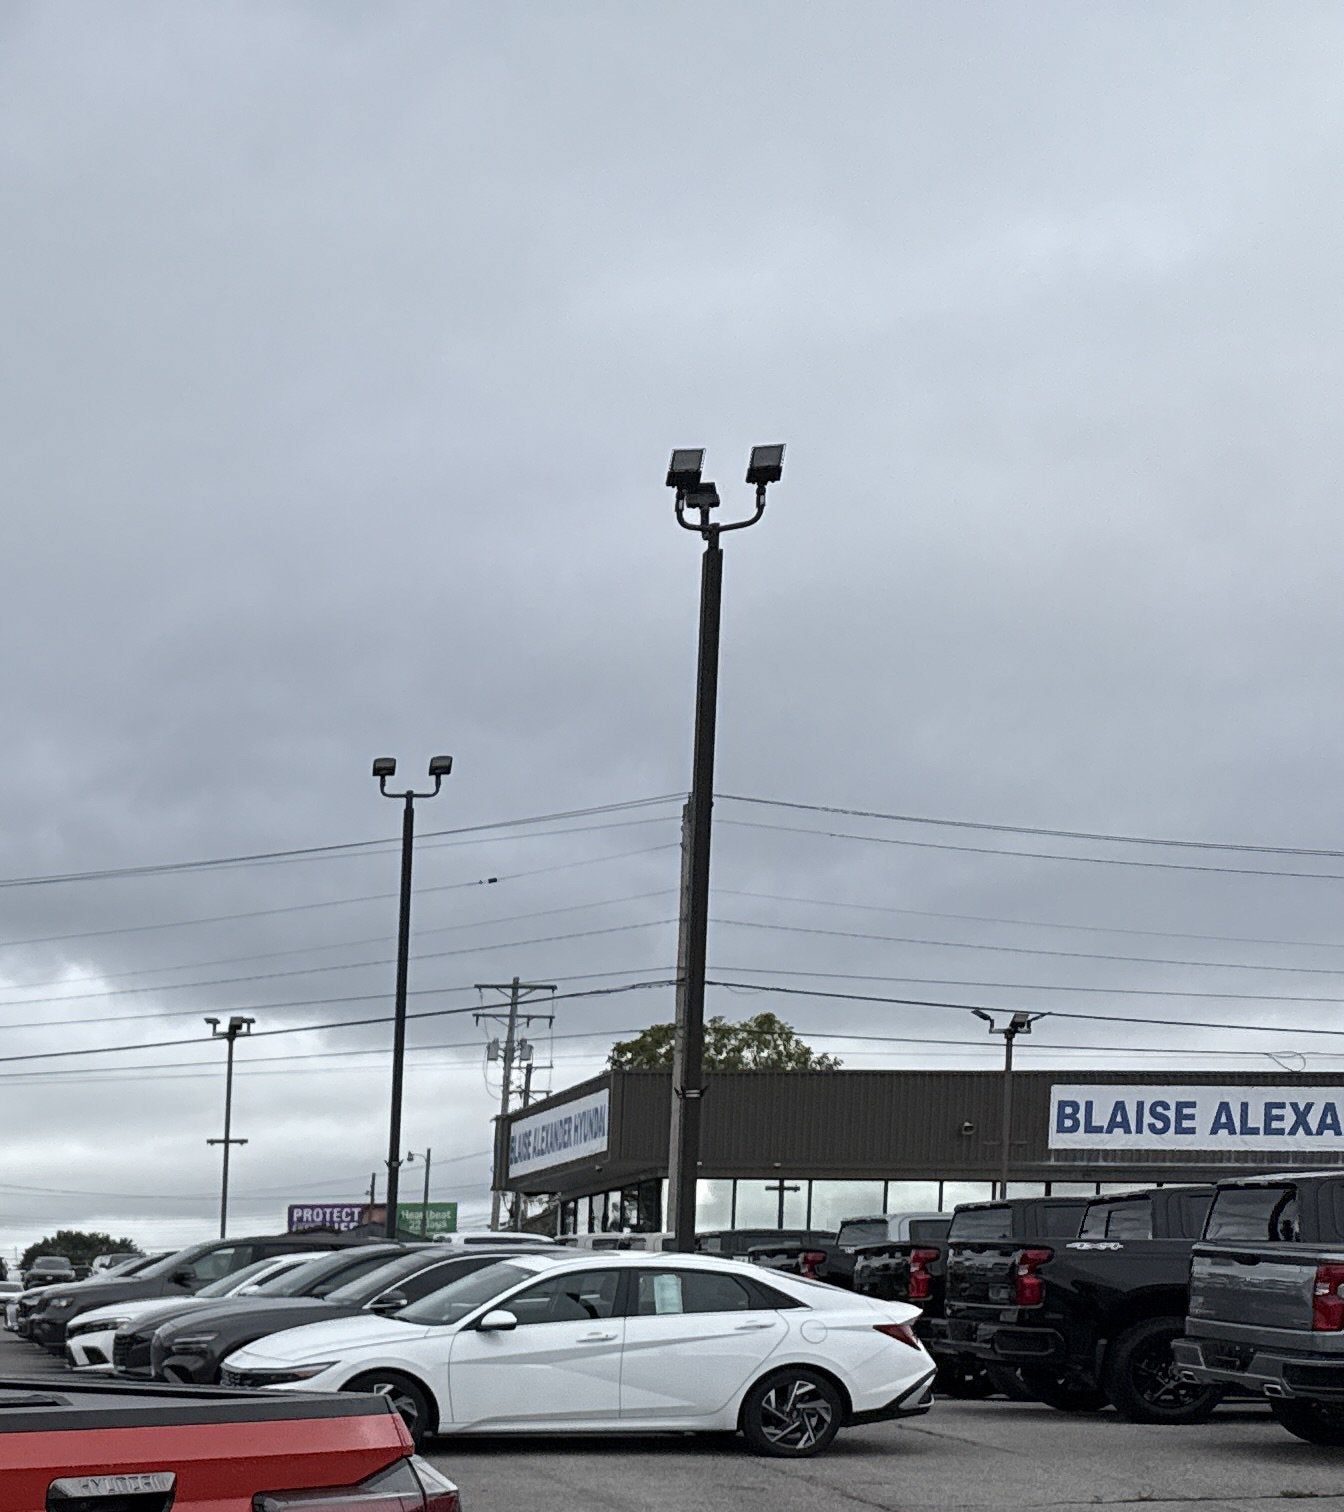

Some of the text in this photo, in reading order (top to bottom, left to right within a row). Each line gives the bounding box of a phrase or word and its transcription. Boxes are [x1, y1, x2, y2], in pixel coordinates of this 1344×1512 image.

[1055, 1099, 1343, 1137] BLAISE ALEXA
[292, 1207, 362, 1222] PROTECT
